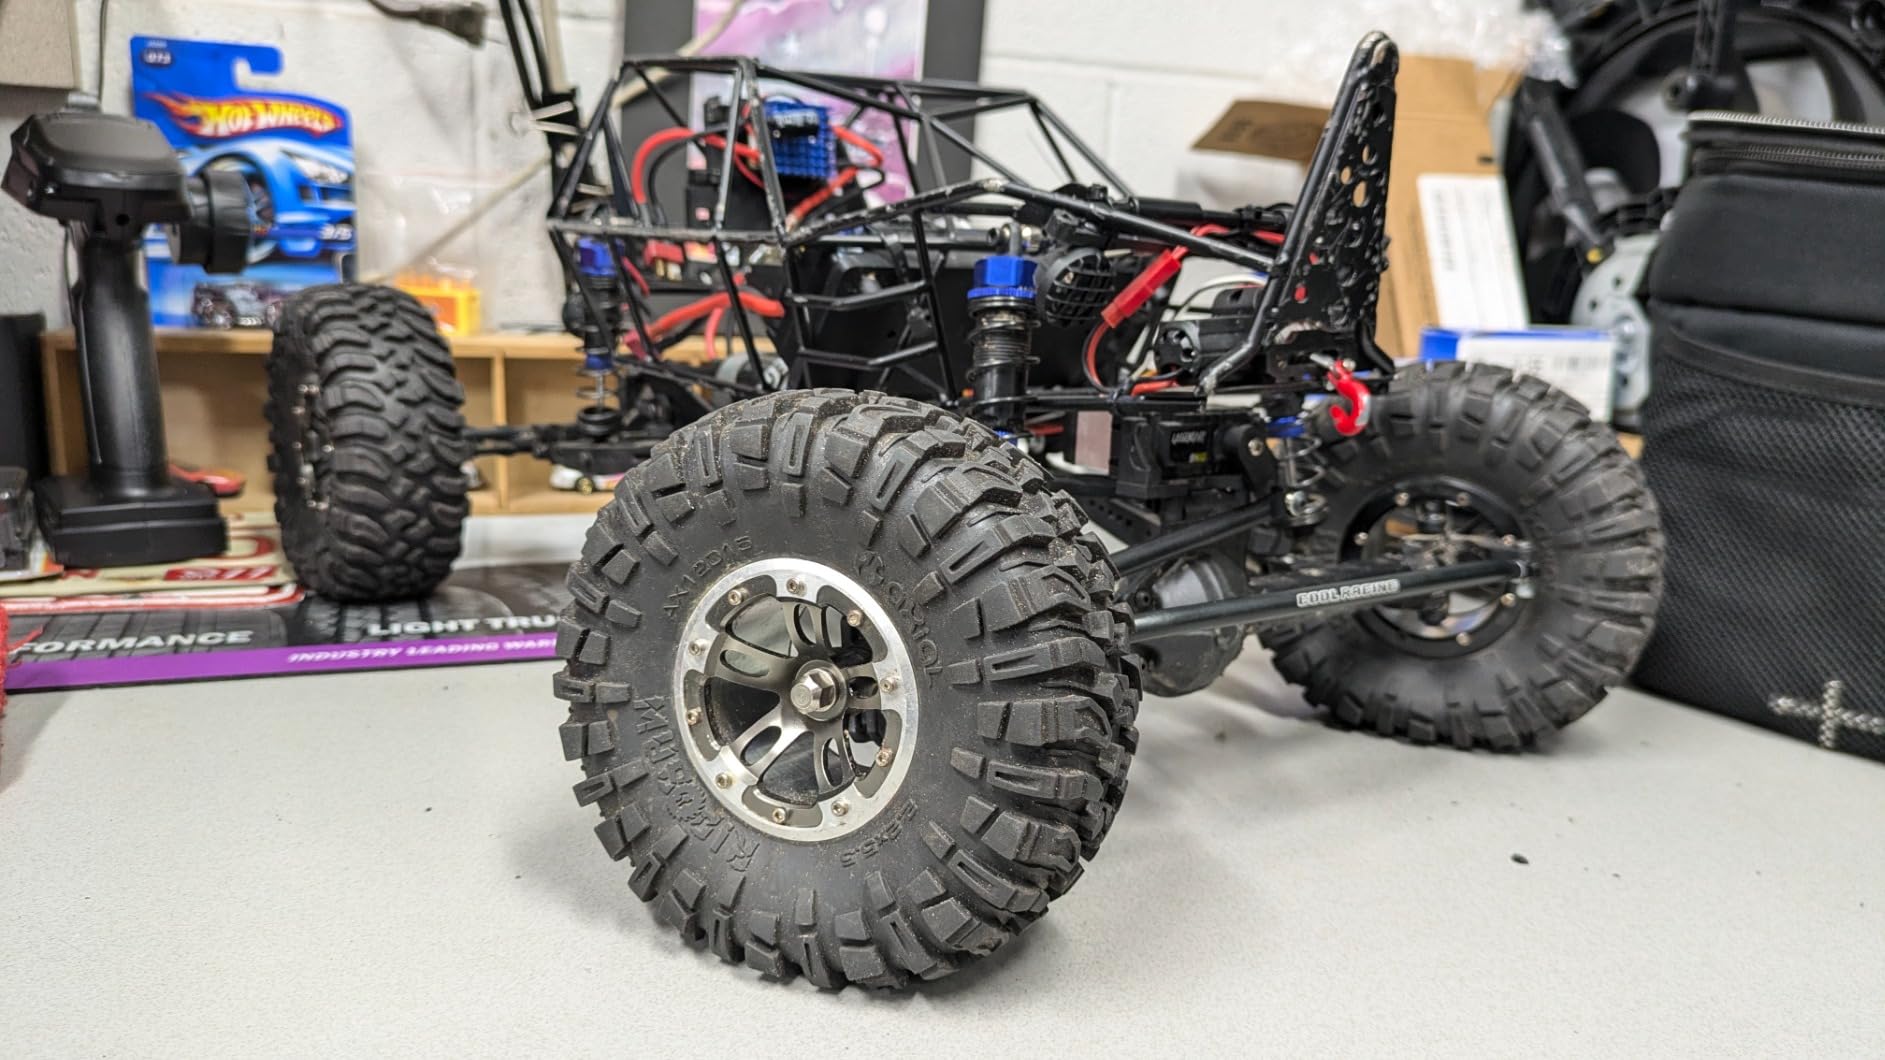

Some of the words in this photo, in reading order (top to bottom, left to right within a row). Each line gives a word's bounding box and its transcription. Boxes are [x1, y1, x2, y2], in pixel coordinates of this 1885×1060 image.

[199, 101, 254, 137] HOT
[1296, 588, 1340, 608] COOL
[367, 618, 480, 636] LIGHT
[483, 614, 560, 630] TRU
[8, 630, 254, 655] FORMANCE
[288, 647, 403, 664] INDUSTRY
[406, 642, 499, 657] LEADING
